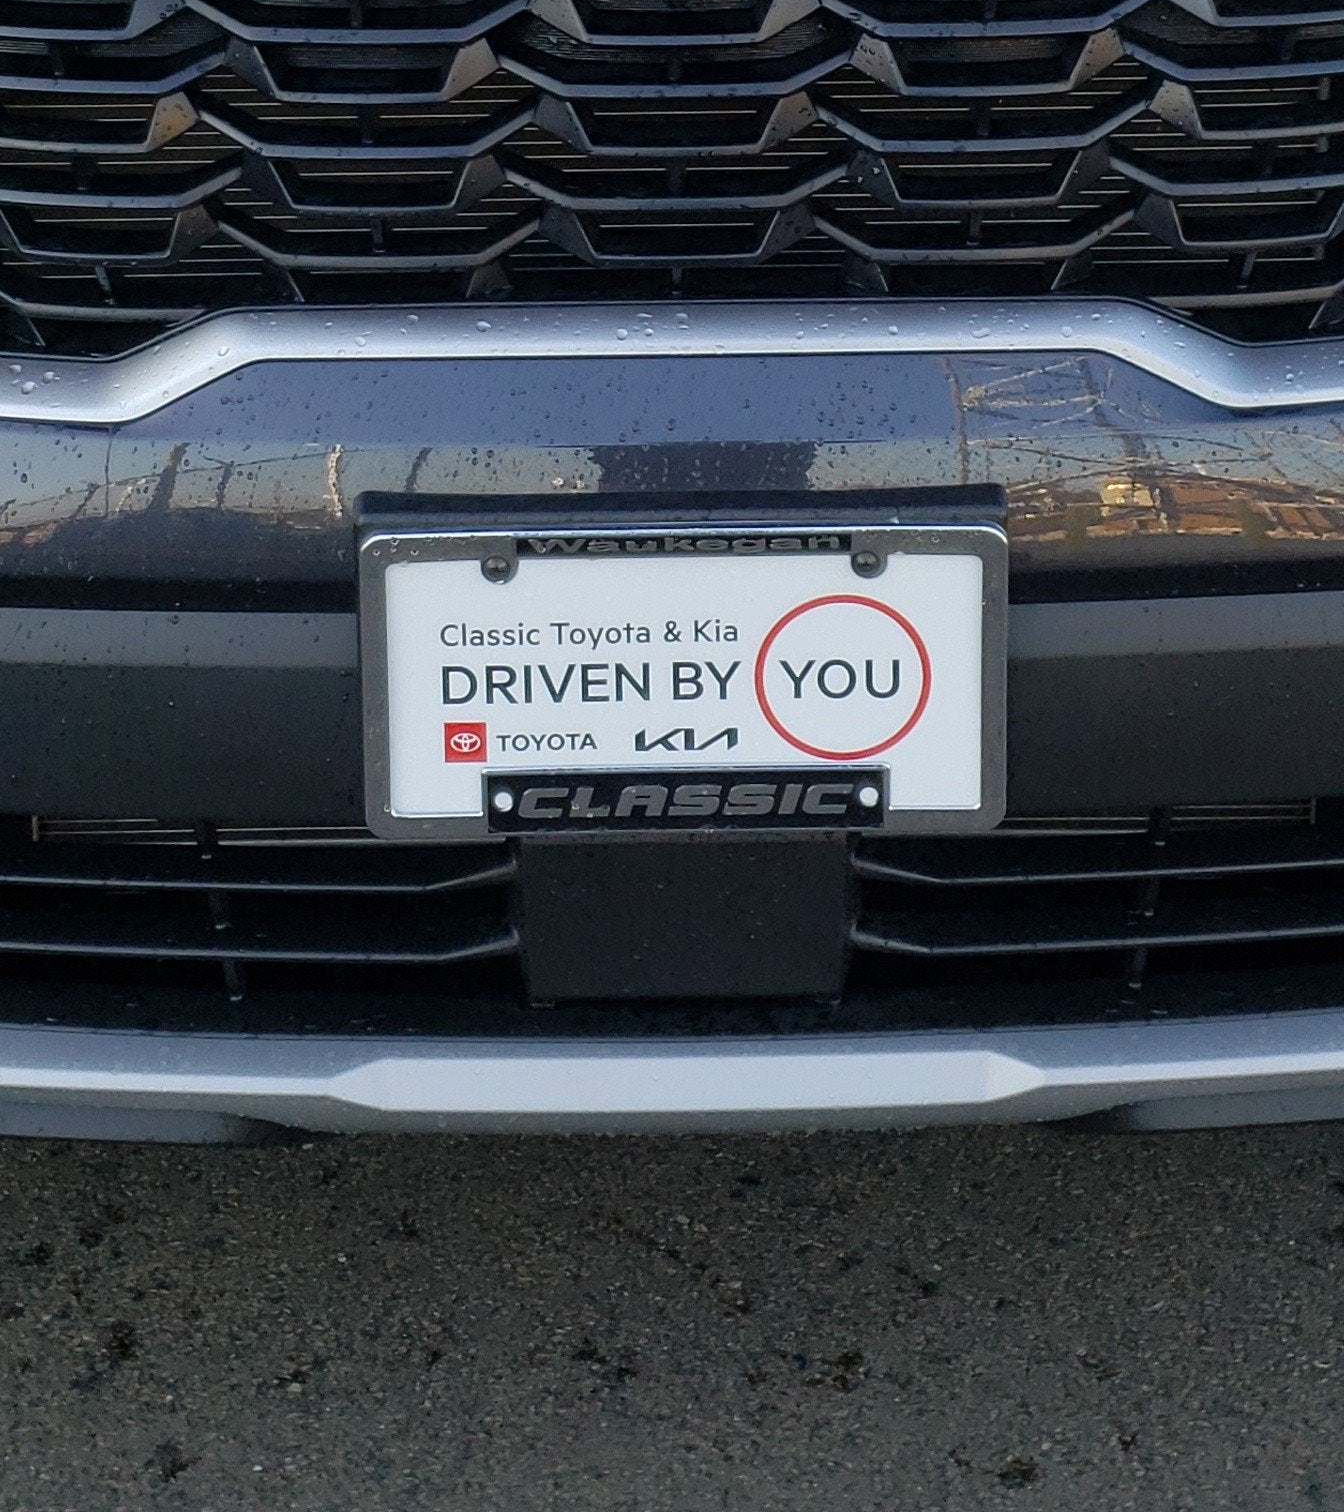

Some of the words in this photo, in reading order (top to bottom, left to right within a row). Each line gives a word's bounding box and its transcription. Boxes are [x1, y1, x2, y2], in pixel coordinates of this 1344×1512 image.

[440, 623, 541, 647] Classic
[549, 622, 651, 650] Toyota
[663, 620, 682, 642] &
[693, 618, 738, 642] Kia
[441, 662, 651, 705] DRIVEN
[672, 660, 741, 701] BY
[779, 659, 900, 700] YOU
[497, 733, 597, 752] TOYOTA
[635, 727, 738, 752] KIA
[517, 783, 855, 819] CLASSIC
